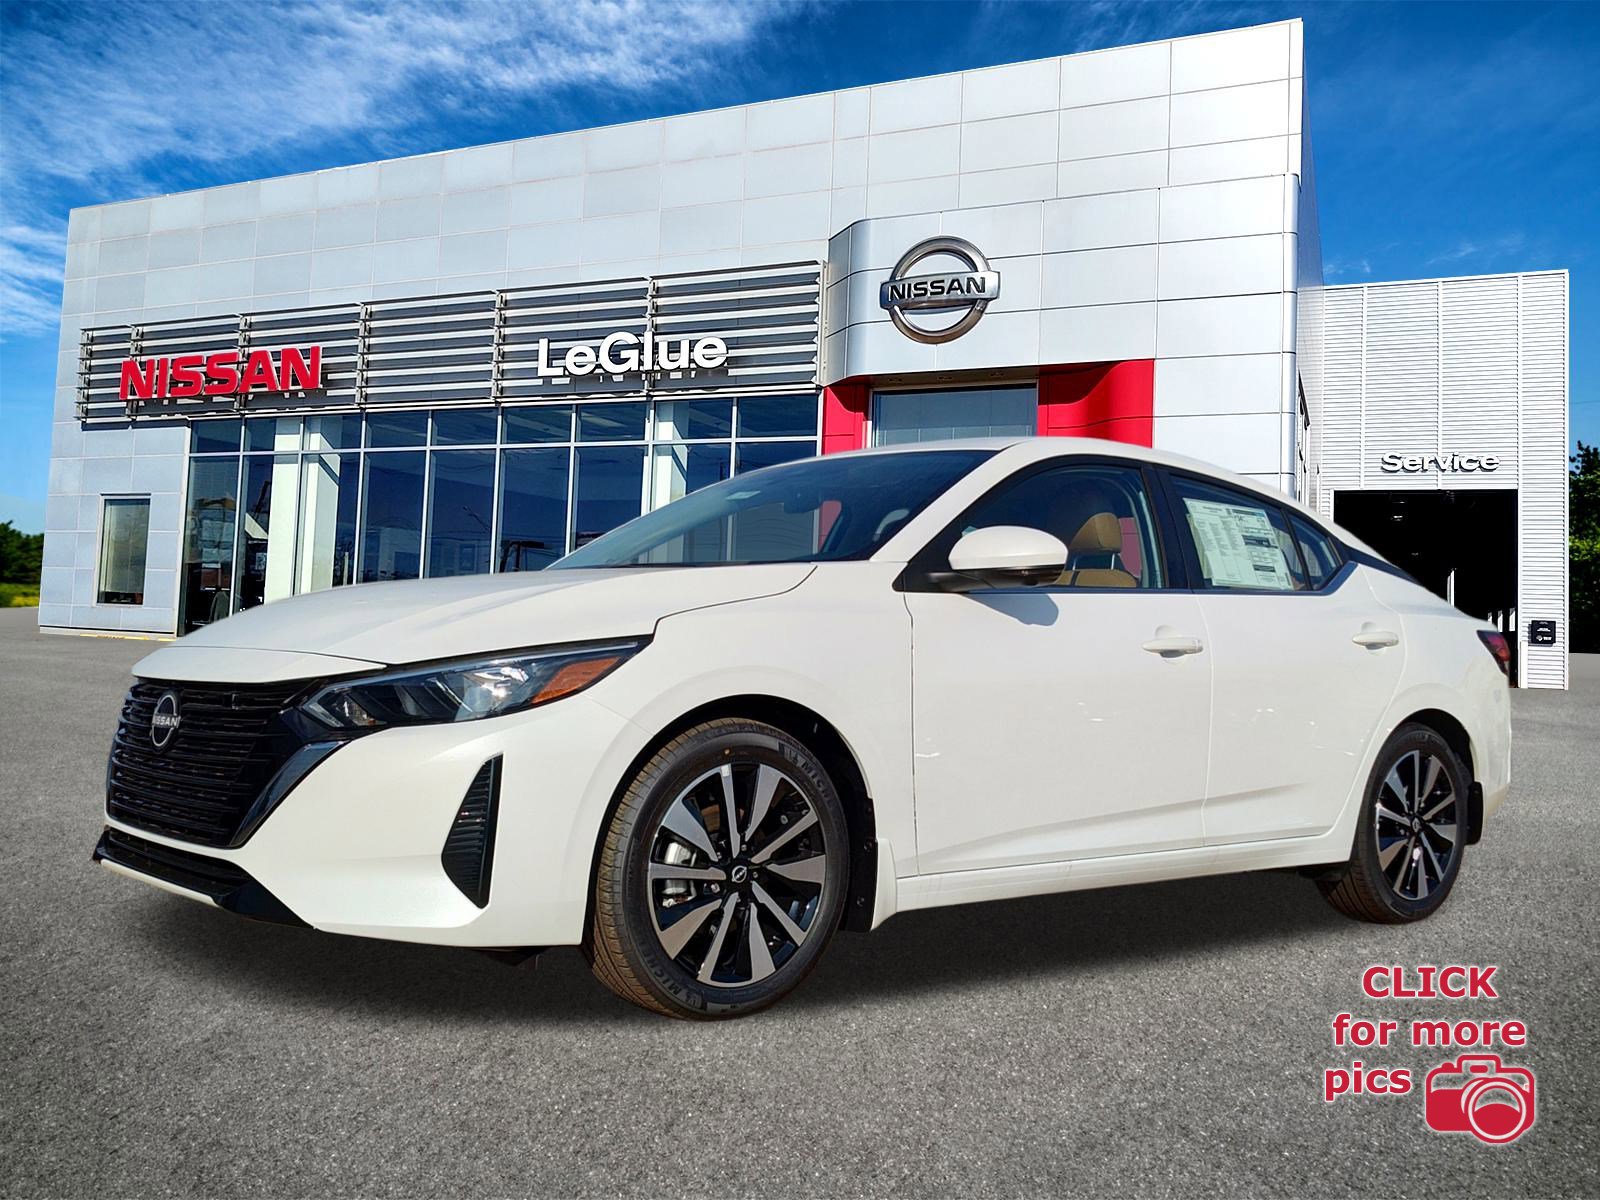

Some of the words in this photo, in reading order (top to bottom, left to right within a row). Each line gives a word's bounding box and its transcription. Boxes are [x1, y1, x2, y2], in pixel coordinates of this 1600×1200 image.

[887, 276, 987, 301] NISSAN
[537, 331, 729, 377] LeGlue
[119, 345, 322, 400] NISSAN
[1381, 451, 1500, 473] Service
